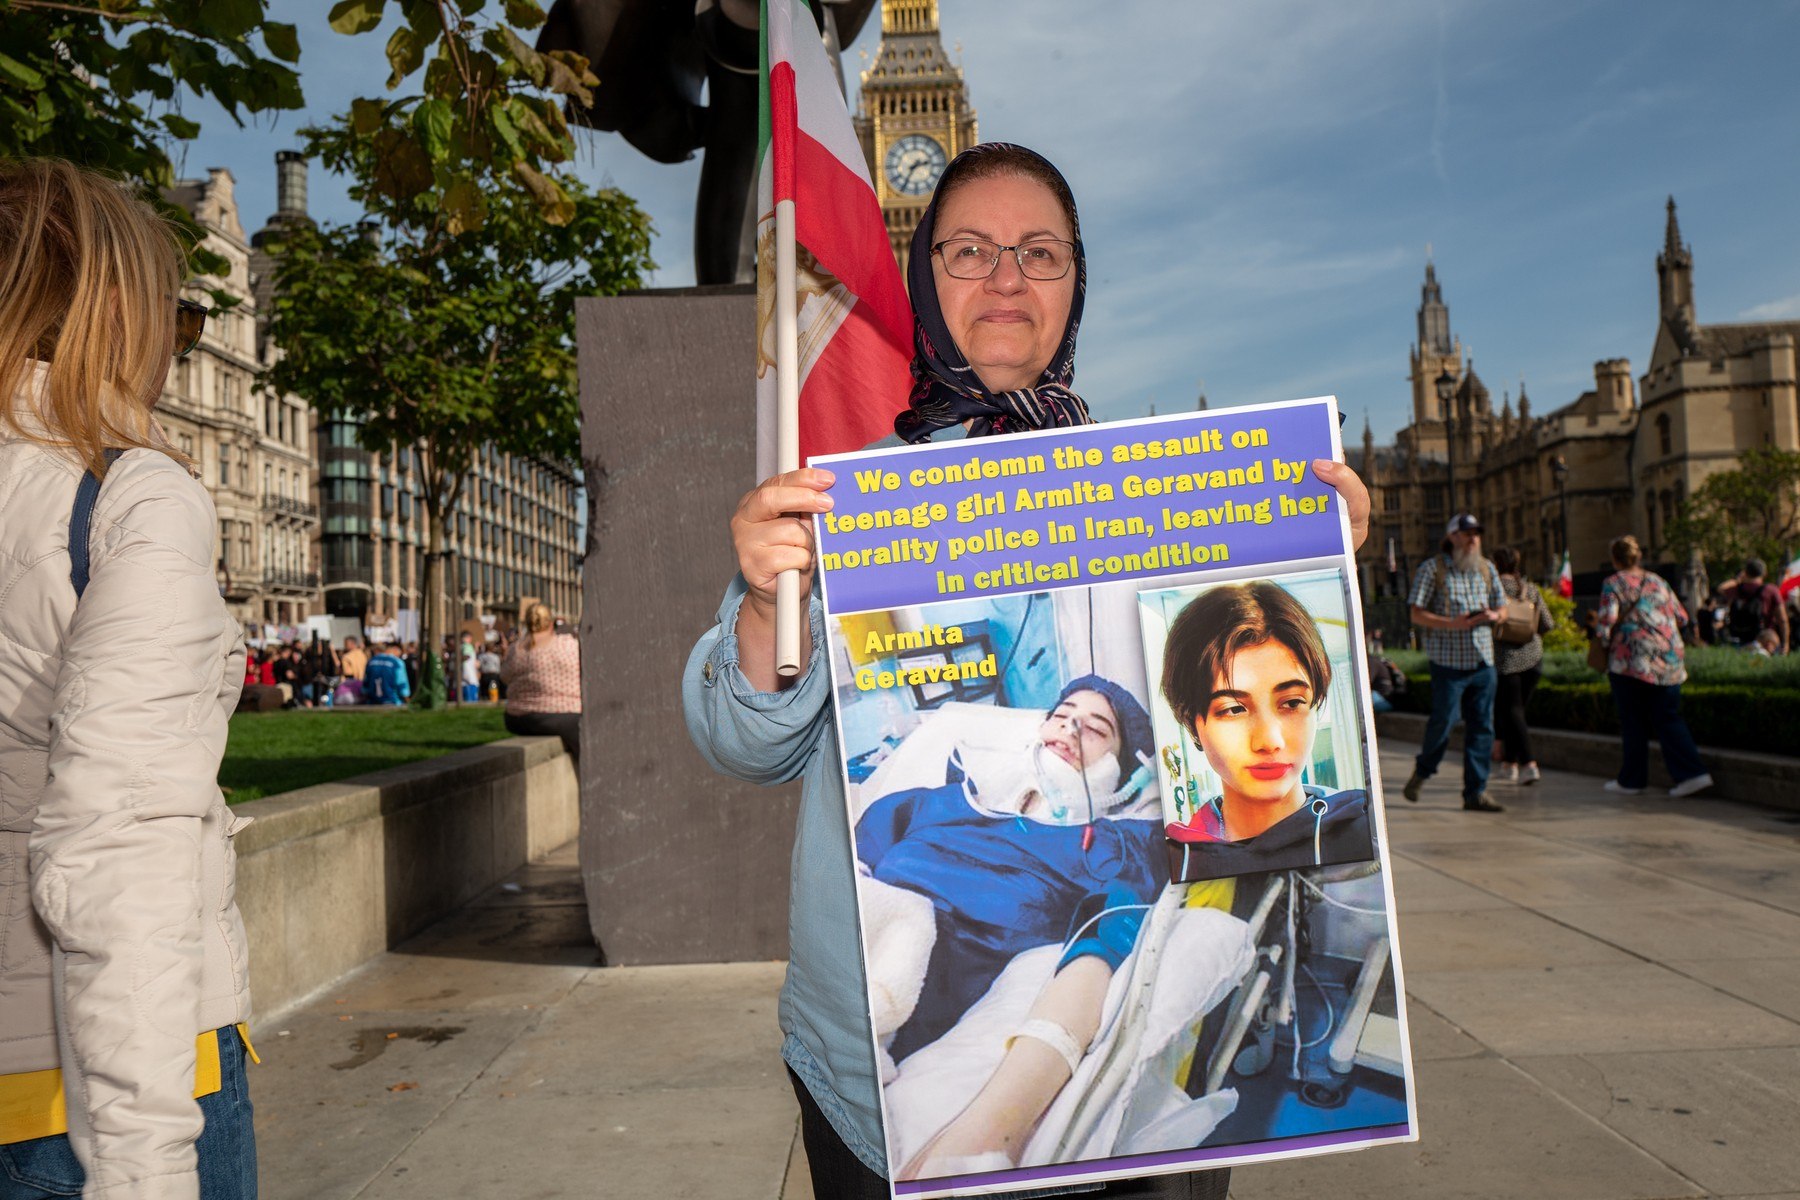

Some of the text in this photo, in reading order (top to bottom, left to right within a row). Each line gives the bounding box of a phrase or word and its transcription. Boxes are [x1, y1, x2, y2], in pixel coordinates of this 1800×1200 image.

[856, 429, 1270, 493] We condemn the assault on
[824, 459, 1308, 534] teenage girl Armita Geravand by
[949, 528, 1039, 560] police
[1049, 521, 1077, 544] in
[1086, 515, 1156, 540] Iran,
[1163, 499, 1273, 532] leaving
[1280, 495, 1330, 518] her
[936, 544, 1229, 594] in critical condition
[864, 623, 963, 654] Armita
[855, 653, 997, 691] Geravand
